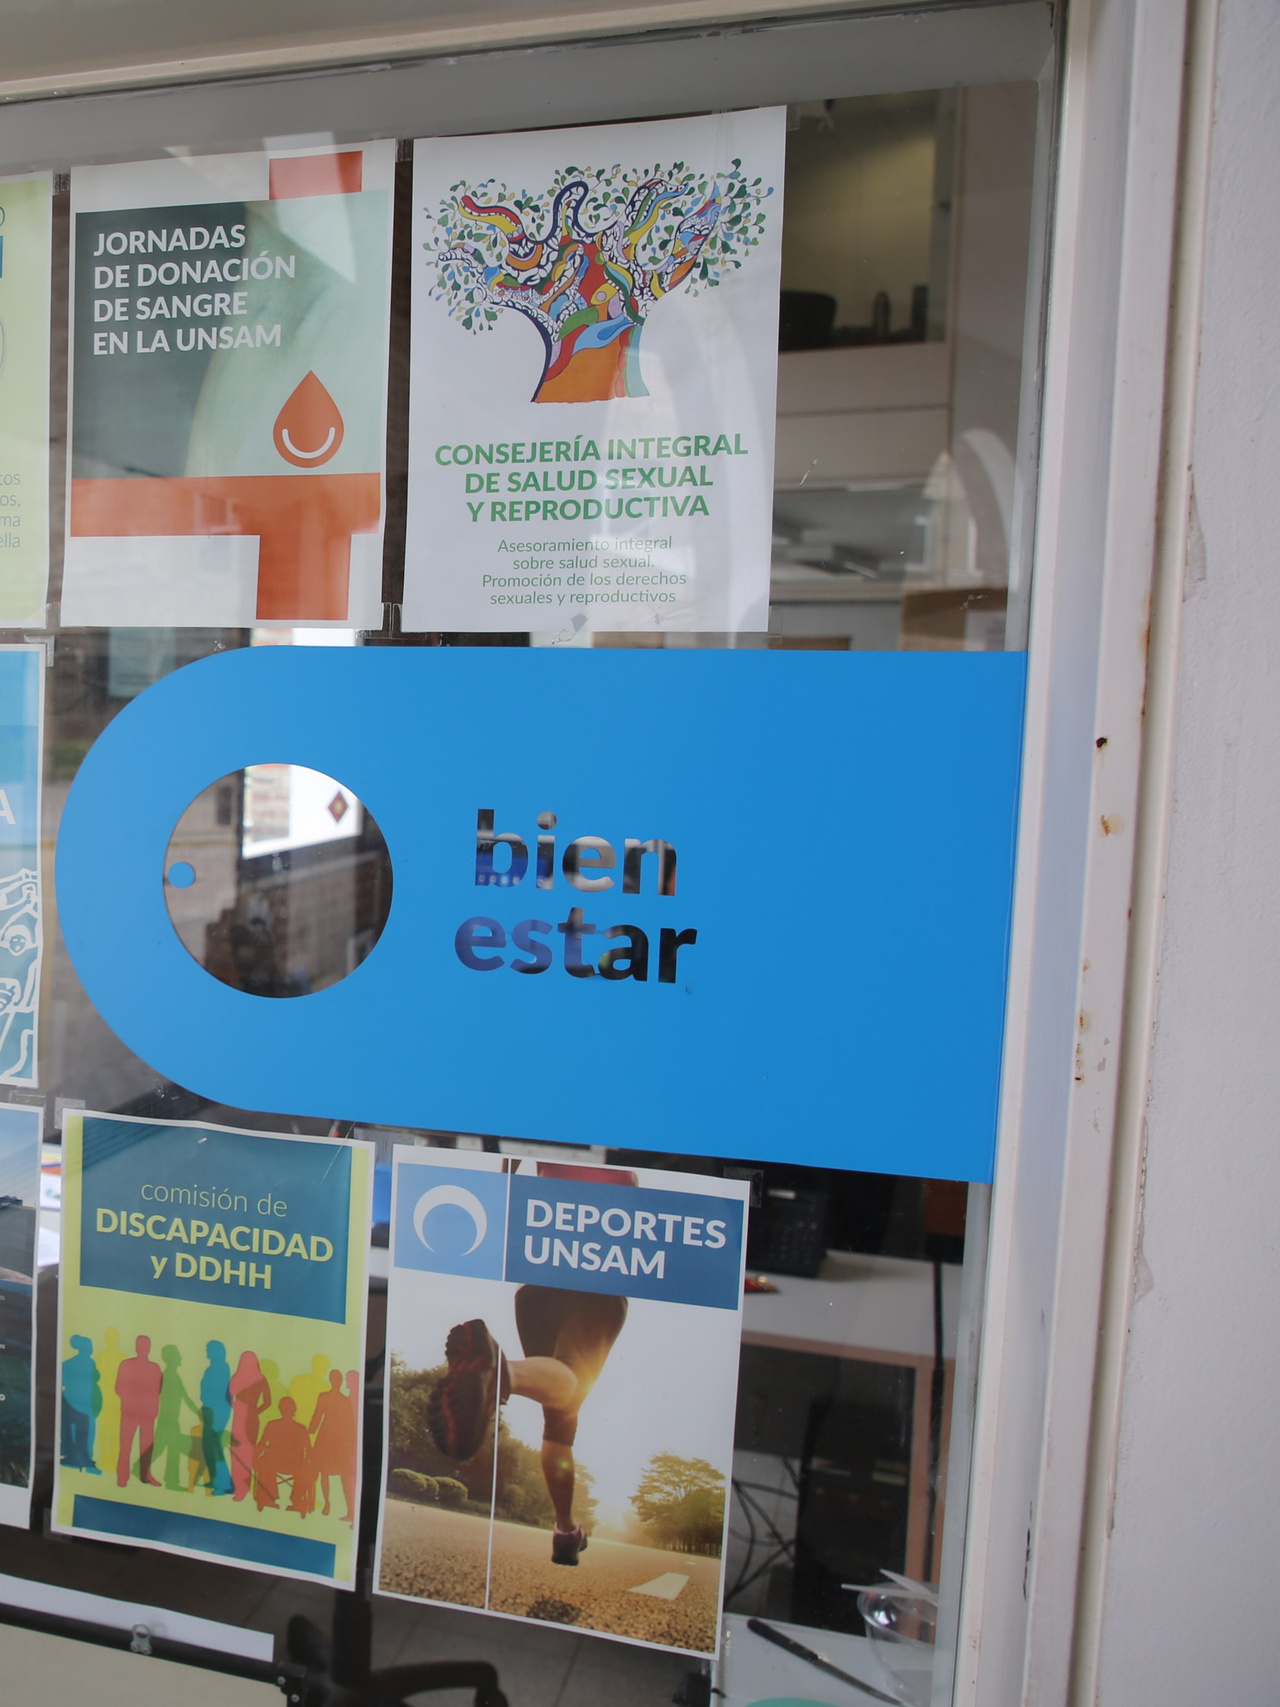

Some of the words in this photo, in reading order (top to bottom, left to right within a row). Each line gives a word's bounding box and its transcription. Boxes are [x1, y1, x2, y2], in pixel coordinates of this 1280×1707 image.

[93, 224, 246, 256] JORNADAS
[94, 265, 130, 289] DE
[137, 250, 296, 287] DONACIÓN
[94, 298, 129, 322] DE
[136, 291, 248, 320] SANGRE
[93, 331, 128, 355] EN
[137, 329, 170, 353] LA
[176, 324, 281, 351] UNSAM
[435, 434, 601, 467] CONSEJERÍA
[607, 433, 748, 460] INTEGRAL
[465, 472, 500, 493] DE
[507, 469, 597, 493] SALUD
[605, 465, 714, 490] SEXUAL
[466, 502, 485, 522] Y
[490, 495, 710, 522] REPRODUCTIVA
[497, 538, 610, 553] Asesoramiento
[614, 536, 672, 554] integral
[513, 556, 554, 570] sobre
[559, 554, 598, 569] salud
[603, 554, 655, 568] sexual.
[482, 573, 562, 587] Promoción
[566, 572, 585, 586] de
[590, 571, 611, 586] los
[616, 571, 687, 586] derechos
[490, 590, 553, 605] sexuales
[557, 594, 564, 606] y
[570, 589, 676, 606] reproductivos
[475, 808, 677, 896] bien
[454, 907, 697, 984] estar
[141, 1183, 247, 1212] comisión
[257, 1193, 288, 1217] de
[96, 1208, 334, 1262] DISCAPACIDAD
[526, 1198, 727, 1249] DEPORTES
[150, 1255, 168, 1279] y
[175, 1252, 272, 1290] DDHH
[524, 1235, 665, 1279] UNSAM
